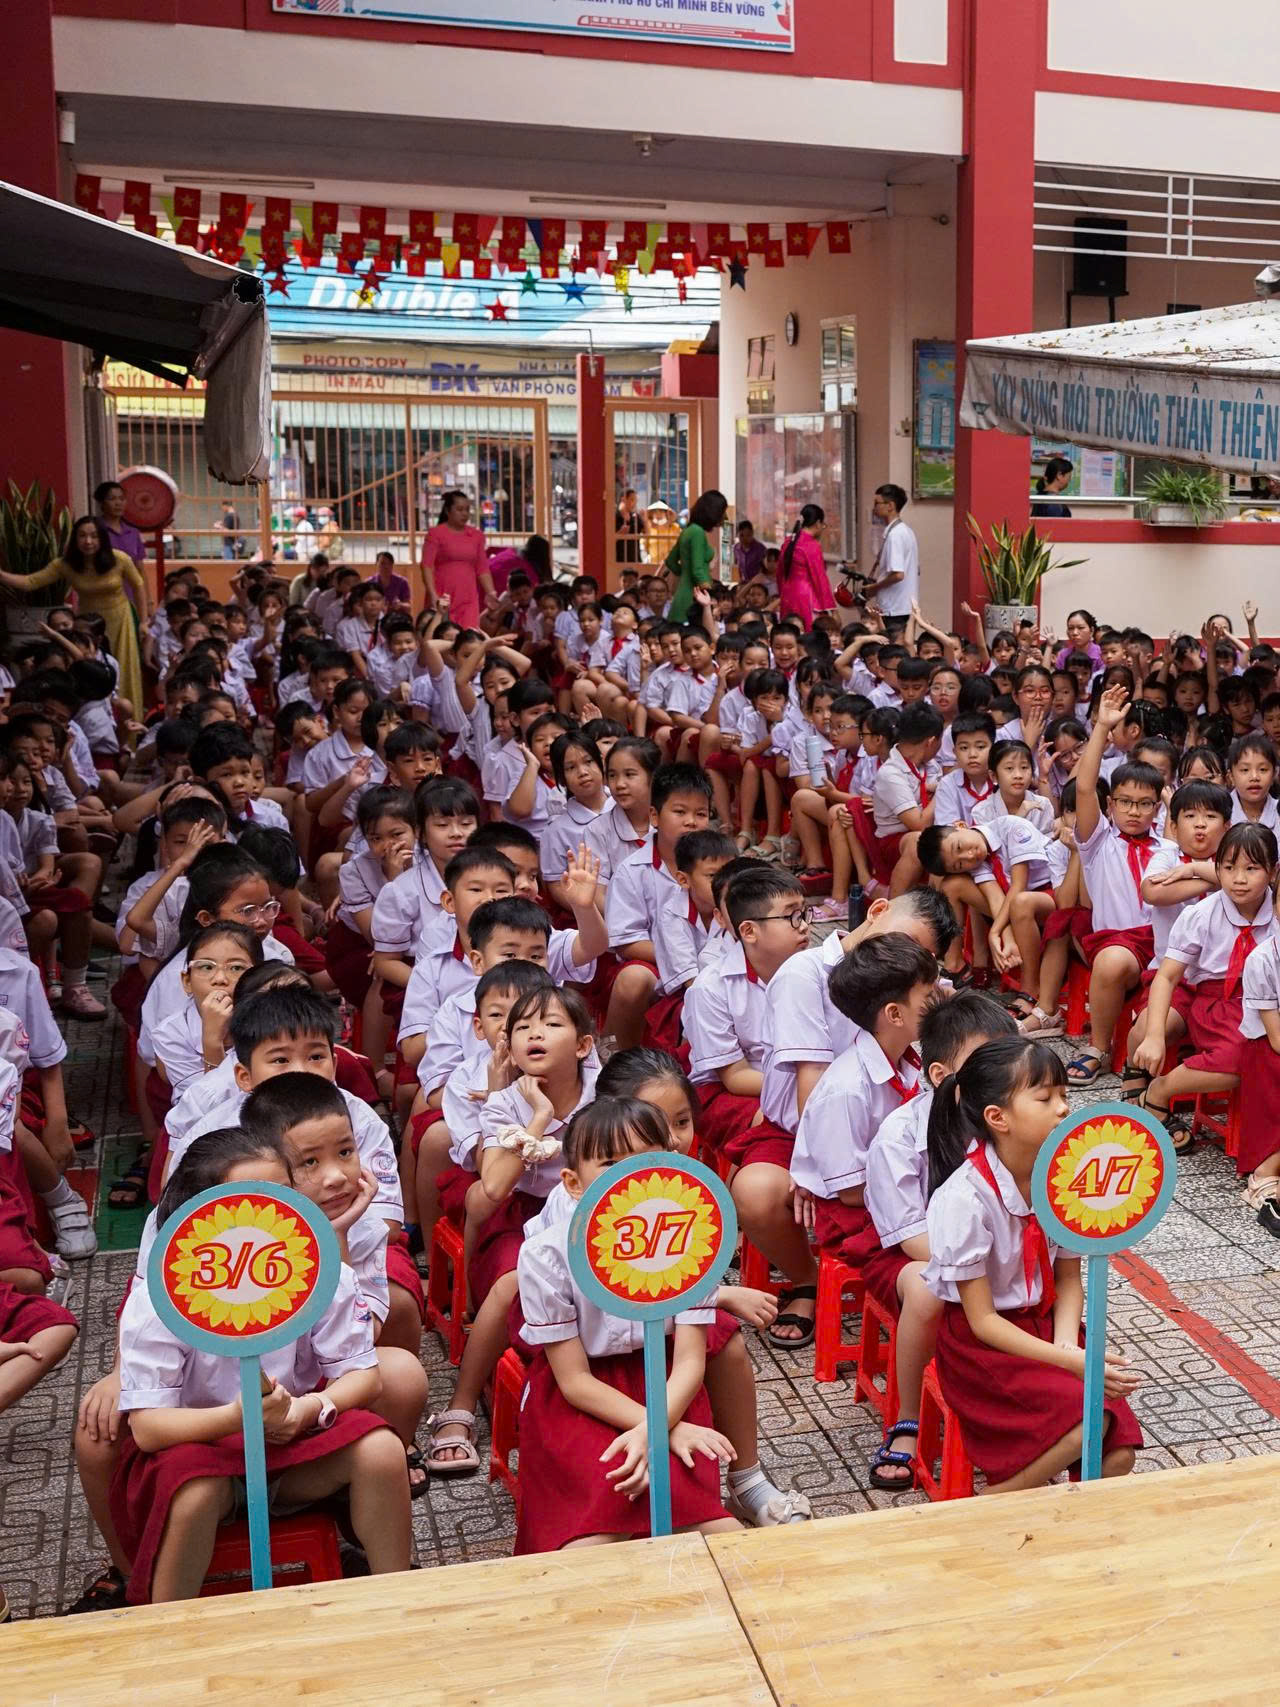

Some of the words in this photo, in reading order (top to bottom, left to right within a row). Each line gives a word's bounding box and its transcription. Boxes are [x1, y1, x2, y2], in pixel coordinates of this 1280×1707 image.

[678, 0, 706, 11] MINH
[328, 375, 344, 388] IN
[992, 362, 1017, 419] XÂY
[1020, 371, 1058, 434] DỰNG
[1062, 372, 1090, 434] MÔI
[1095, 376, 1161, 446] TRƯỜNG
[1166, 381, 1214, 453] THÂN
[1219, 387, 1280, 472] THIỆN
[1067, 1154, 1143, 1198] 4/7
[612, 1209, 697, 1261] 3/7
[190, 1240, 293, 1290] 3/6
